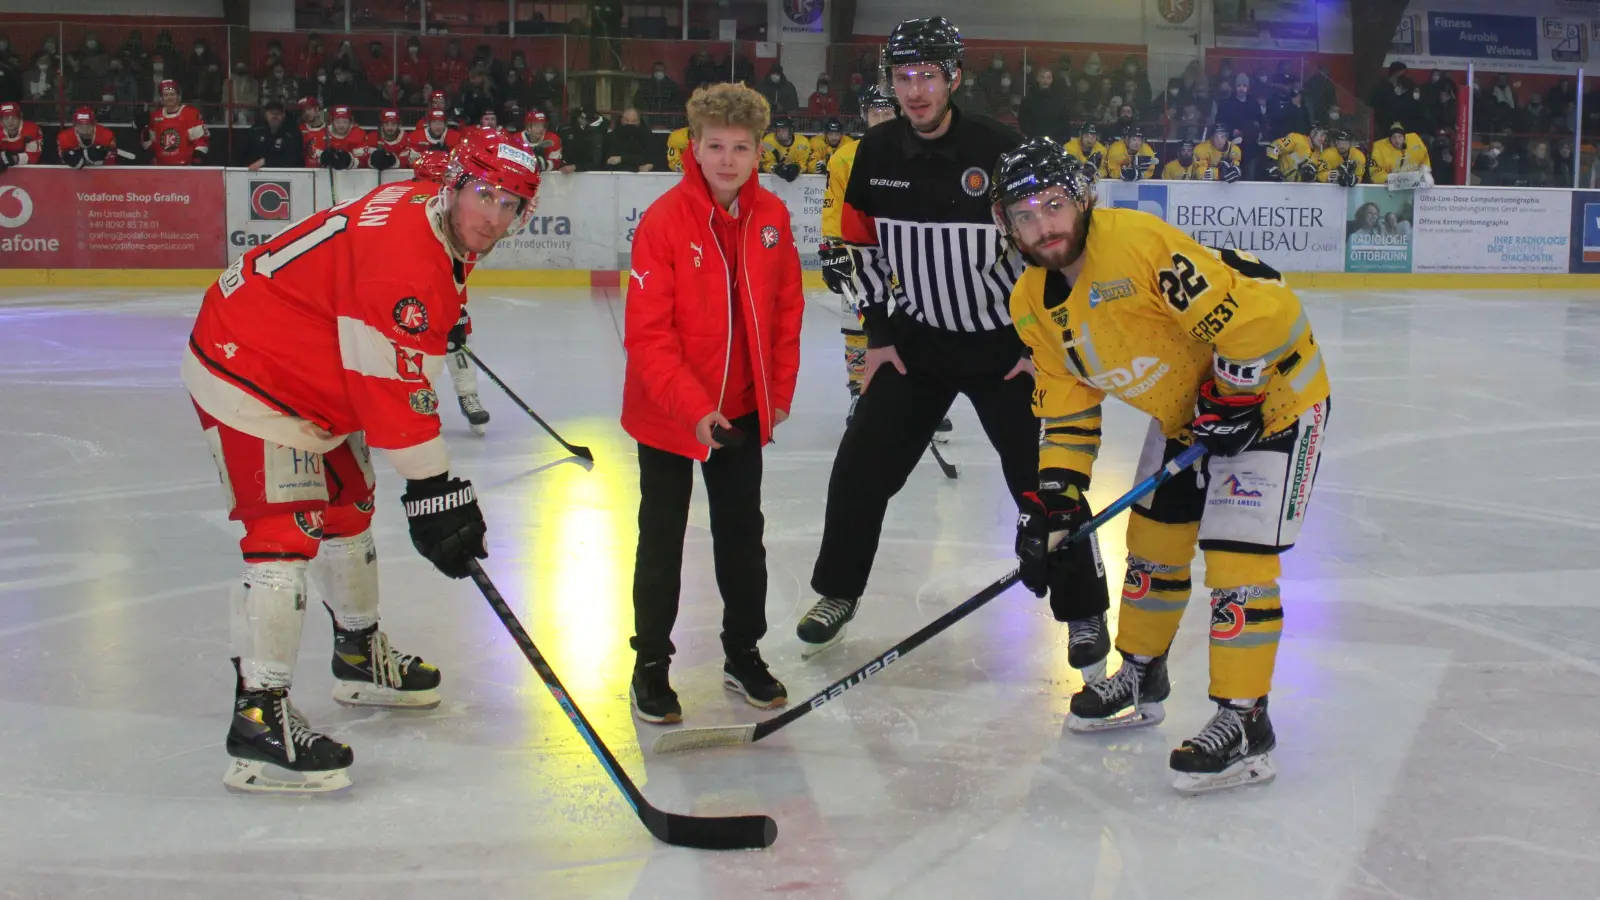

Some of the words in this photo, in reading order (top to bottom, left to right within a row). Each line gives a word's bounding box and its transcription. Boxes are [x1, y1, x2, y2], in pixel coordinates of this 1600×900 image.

[1434, 17, 1473, 28] Fitness
[1460, 32, 1498, 42] Aerobic
[1486, 46, 1532, 56] Wellness
[870, 178, 910, 189] BAUER
[1006, 174, 1035, 192] BAUER
[77, 192, 124, 202] Vodafone
[126, 192, 151, 204] Shop
[153, 192, 190, 204] Grafing
[88, 211, 102, 219] Am
[143, 211, 149, 219] 2
[1176, 206, 1324, 228] BERGMEISTER
[88, 221, 104, 230] +49
[106, 221, 125, 230] 8092
[1442, 218, 1510, 228] Kernspintomographie
[514, 239, 571, 250] Productivity
[1351, 234, 1408, 245] RADIOLOGIE
[1494, 236, 1514, 244] IHRE
[1515, 236, 1568, 246] RADIOLOGIE
[1487, 245, 1504, 254] DER
[1350, 251, 1407, 261] OTTOBRUNN
[1501, 254, 1554, 262] DIAGNOSTIK
[1158, 252, 1210, 312] 22
[1237, 499, 1262, 508] AMBERG
[810, 650, 901, 710] BAUER
